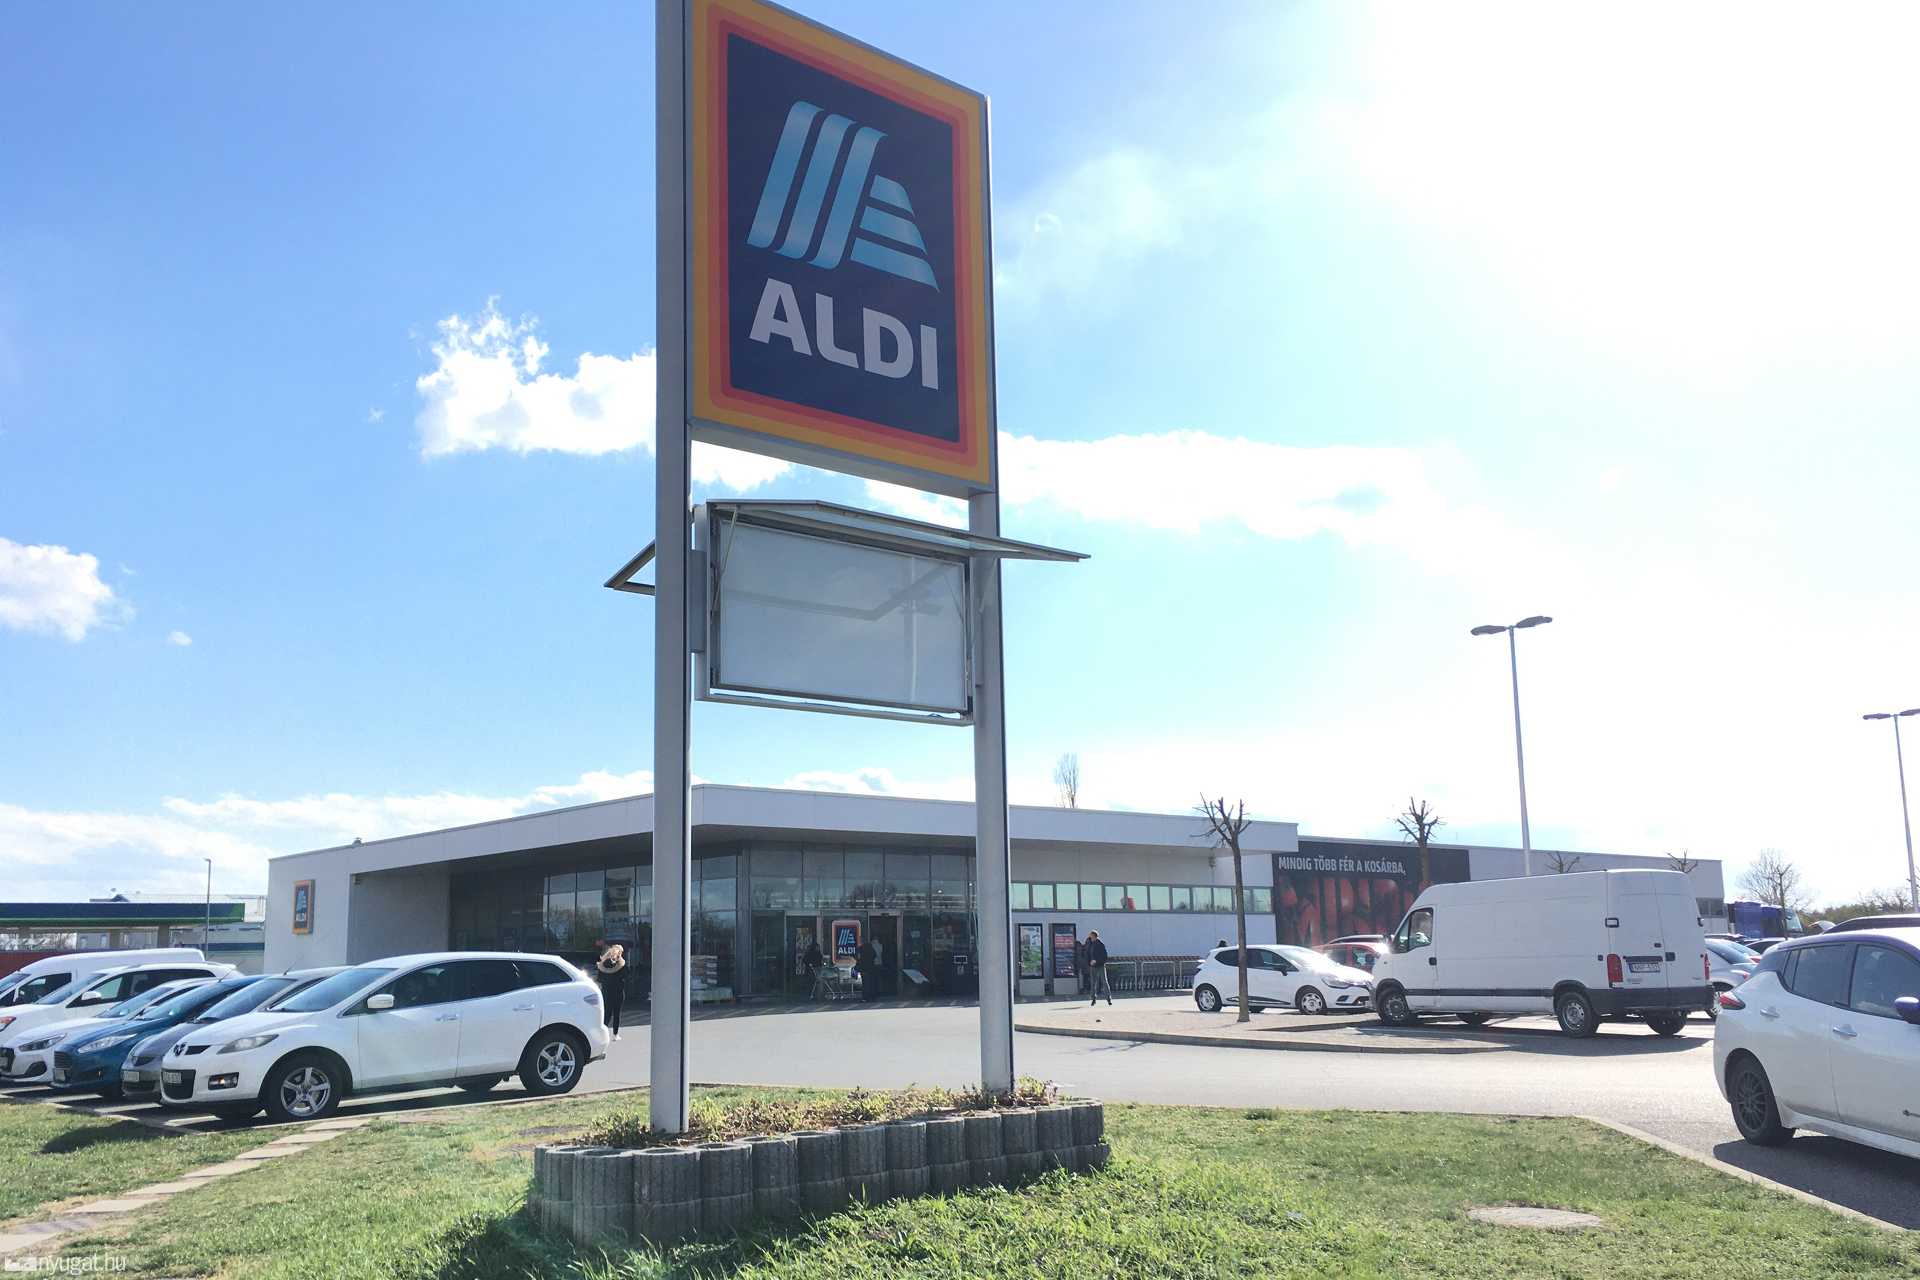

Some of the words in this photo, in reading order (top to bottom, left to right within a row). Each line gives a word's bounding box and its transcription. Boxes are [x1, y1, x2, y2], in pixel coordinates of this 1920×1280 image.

[749, 278, 939, 390] ALDI
[1278, 856, 1312, 870] MINDIG
[1314, 855, 1337, 872] TÖBB
[1339, 856, 1355, 872] FÉR
[1356, 860, 1363, 873] A
[838, 946, 856, 955] ALDI
